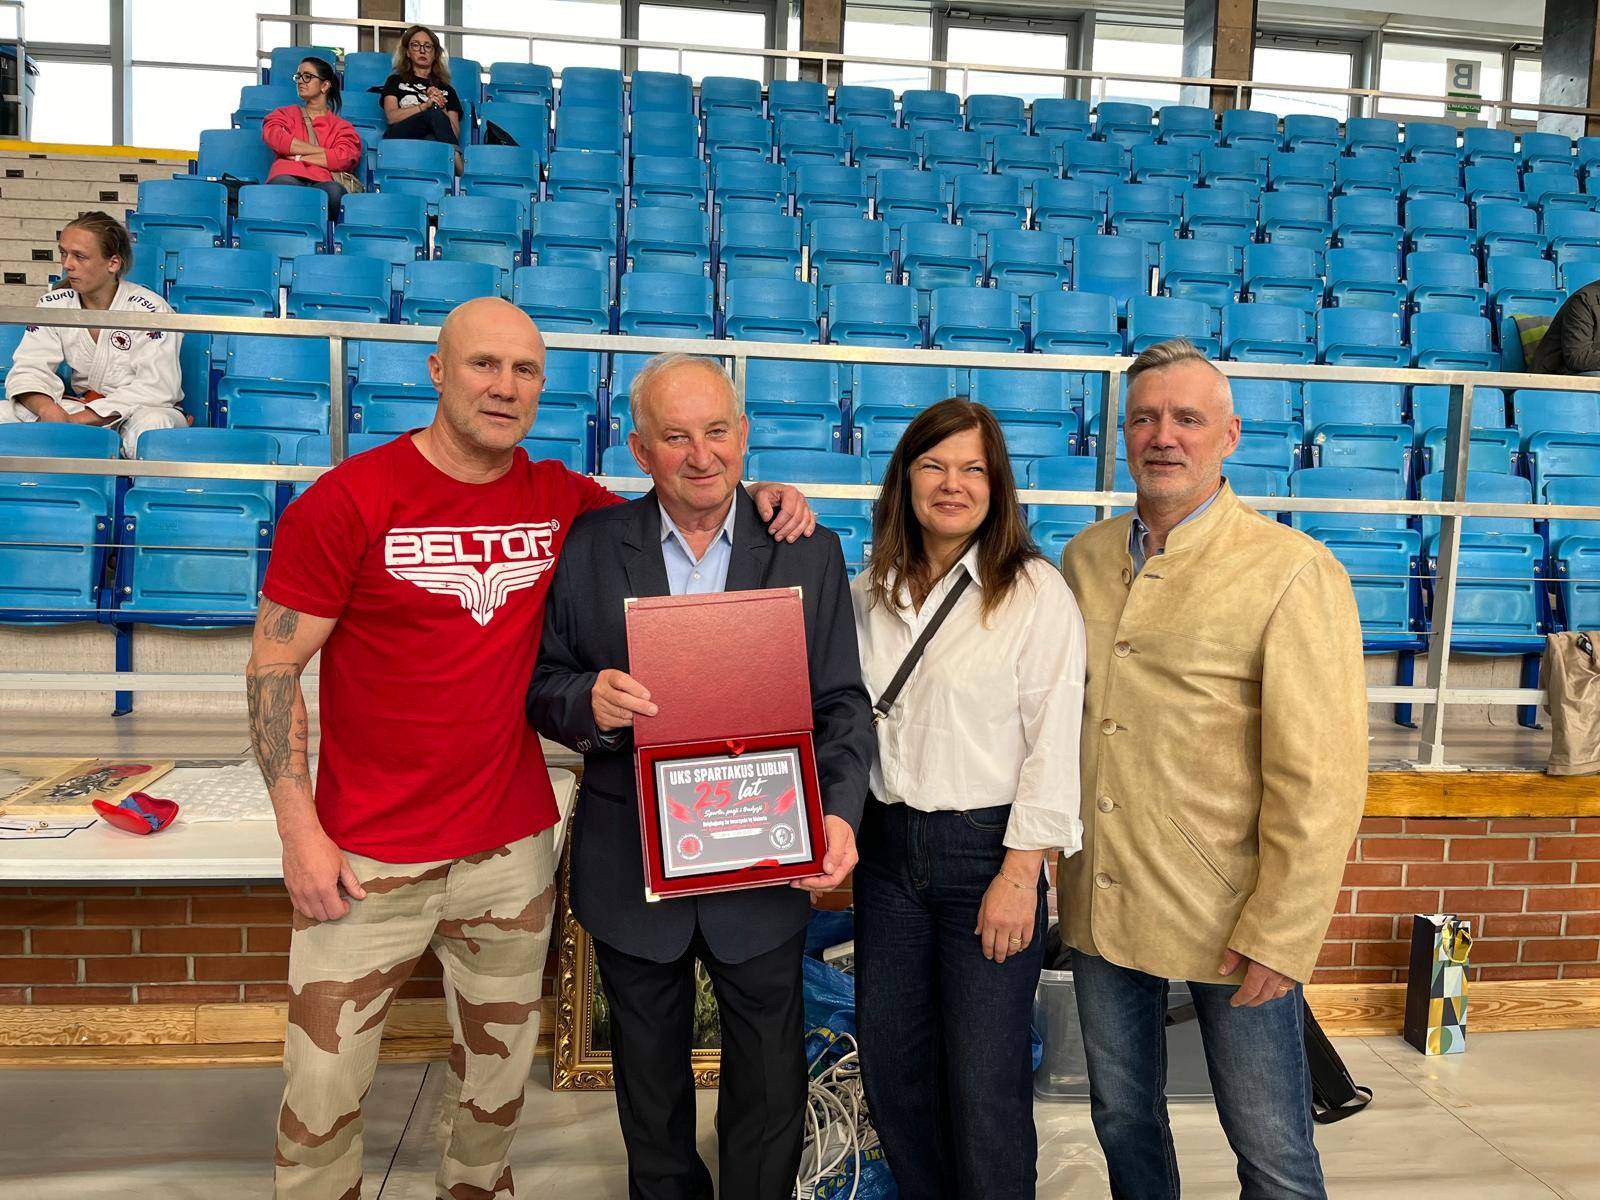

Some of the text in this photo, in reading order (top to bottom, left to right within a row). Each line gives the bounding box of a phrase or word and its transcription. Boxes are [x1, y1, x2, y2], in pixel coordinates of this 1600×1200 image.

[669, 760, 789, 785] UKS SPARTAKUS LUBLIN
[694, 777, 768, 811] 25 lat
